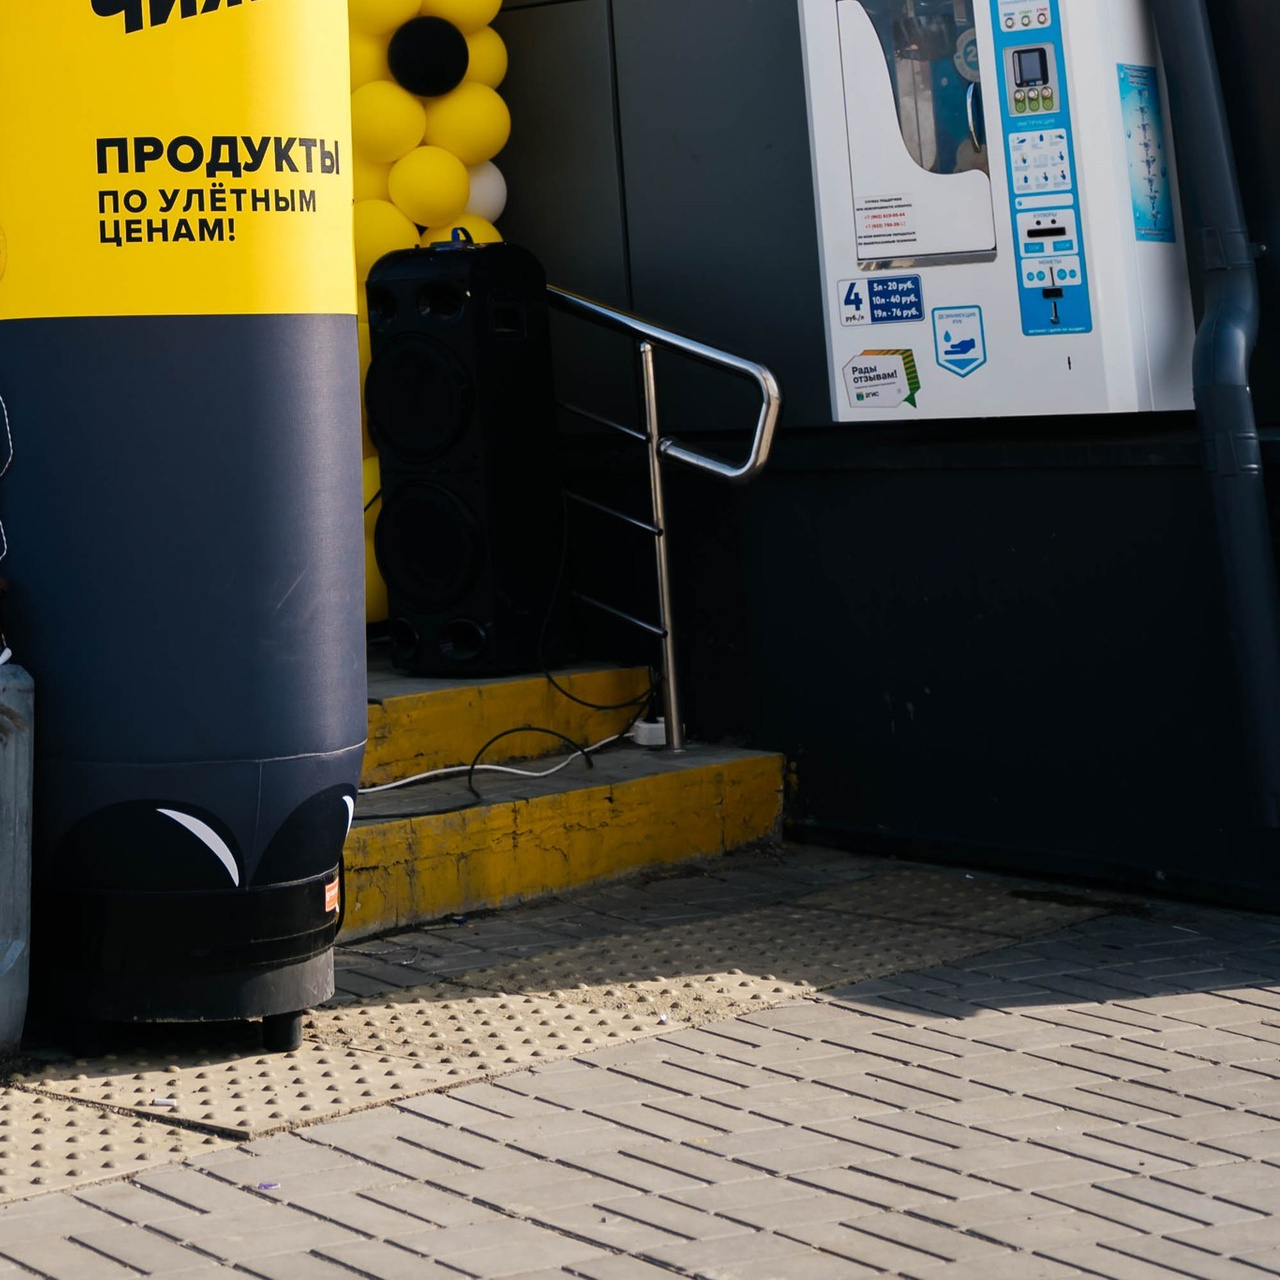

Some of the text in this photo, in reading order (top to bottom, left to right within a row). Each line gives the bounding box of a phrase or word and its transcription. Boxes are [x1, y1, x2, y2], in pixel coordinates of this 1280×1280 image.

[96, 135, 340, 178] ПРОДУКТЫ
[98, 182, 317, 214] ПО УЛЁТНЫМ
[99, 219, 236, 247] ЦЕНАМ!
[873, 283, 883, 291] 5л
[887, 282, 898, 290] 20
[898, 281, 915, 291] руб.
[844, 282, 863, 311] 4
[872, 296, 886, 304] 10л
[890, 295, 901, 303] 40
[901, 294, 918, 304] руб.
[873, 309, 887, 318] 19л
[891, 308, 902, 317] 76
[902, 307, 919, 318] руб.
[852, 365, 877, 375] Рады
[853, 369, 898, 383] отзывам!
